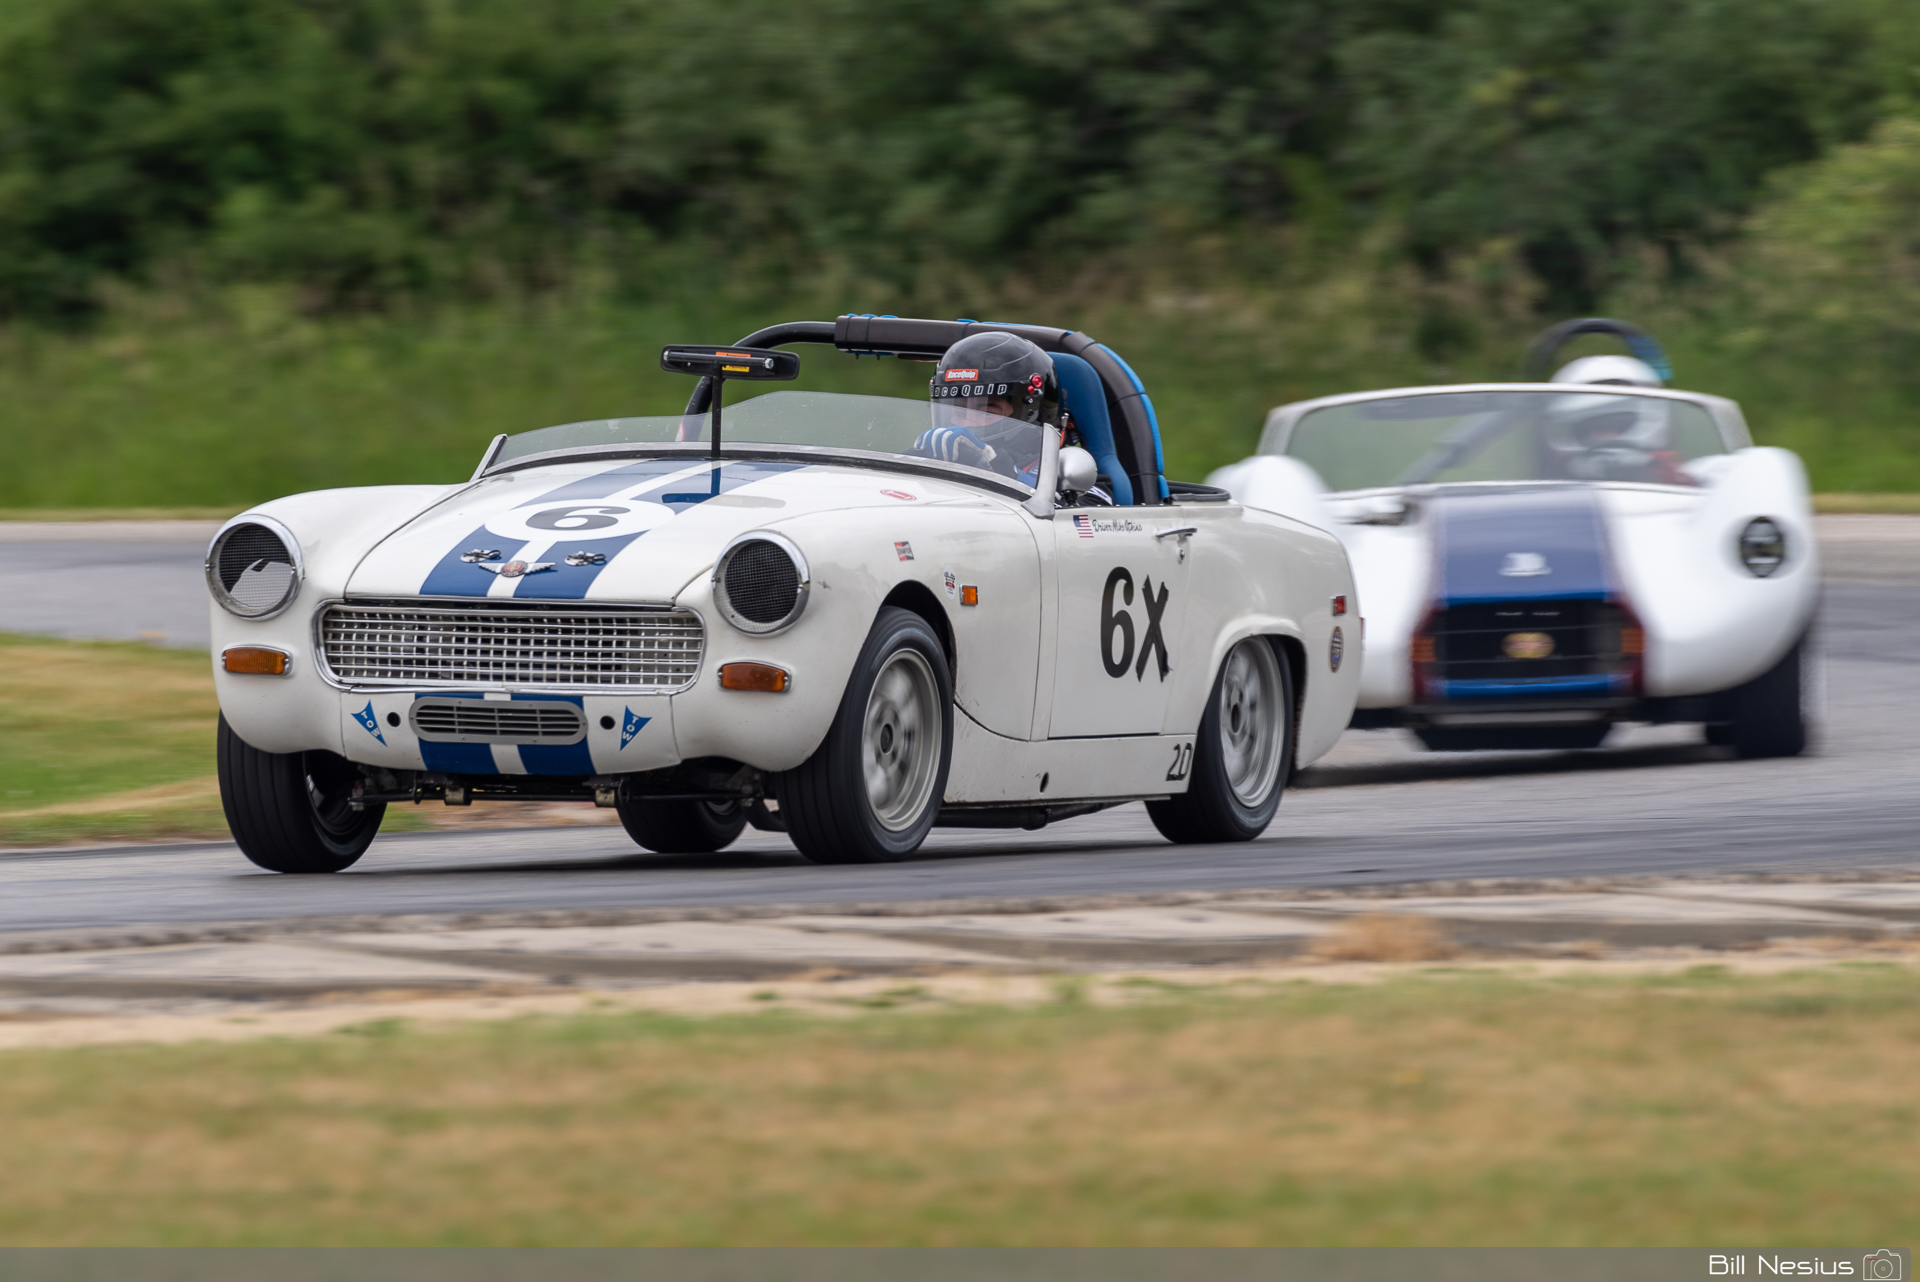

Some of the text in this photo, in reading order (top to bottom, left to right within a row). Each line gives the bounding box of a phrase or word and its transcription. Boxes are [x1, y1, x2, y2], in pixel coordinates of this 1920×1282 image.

[947, 370, 976, 379] RaceQuip
[525, 505, 632, 531] 6
[1101, 566, 1172, 683] 6X
[361, 710, 380, 737] TOW
[622, 715, 639, 741] TOW
